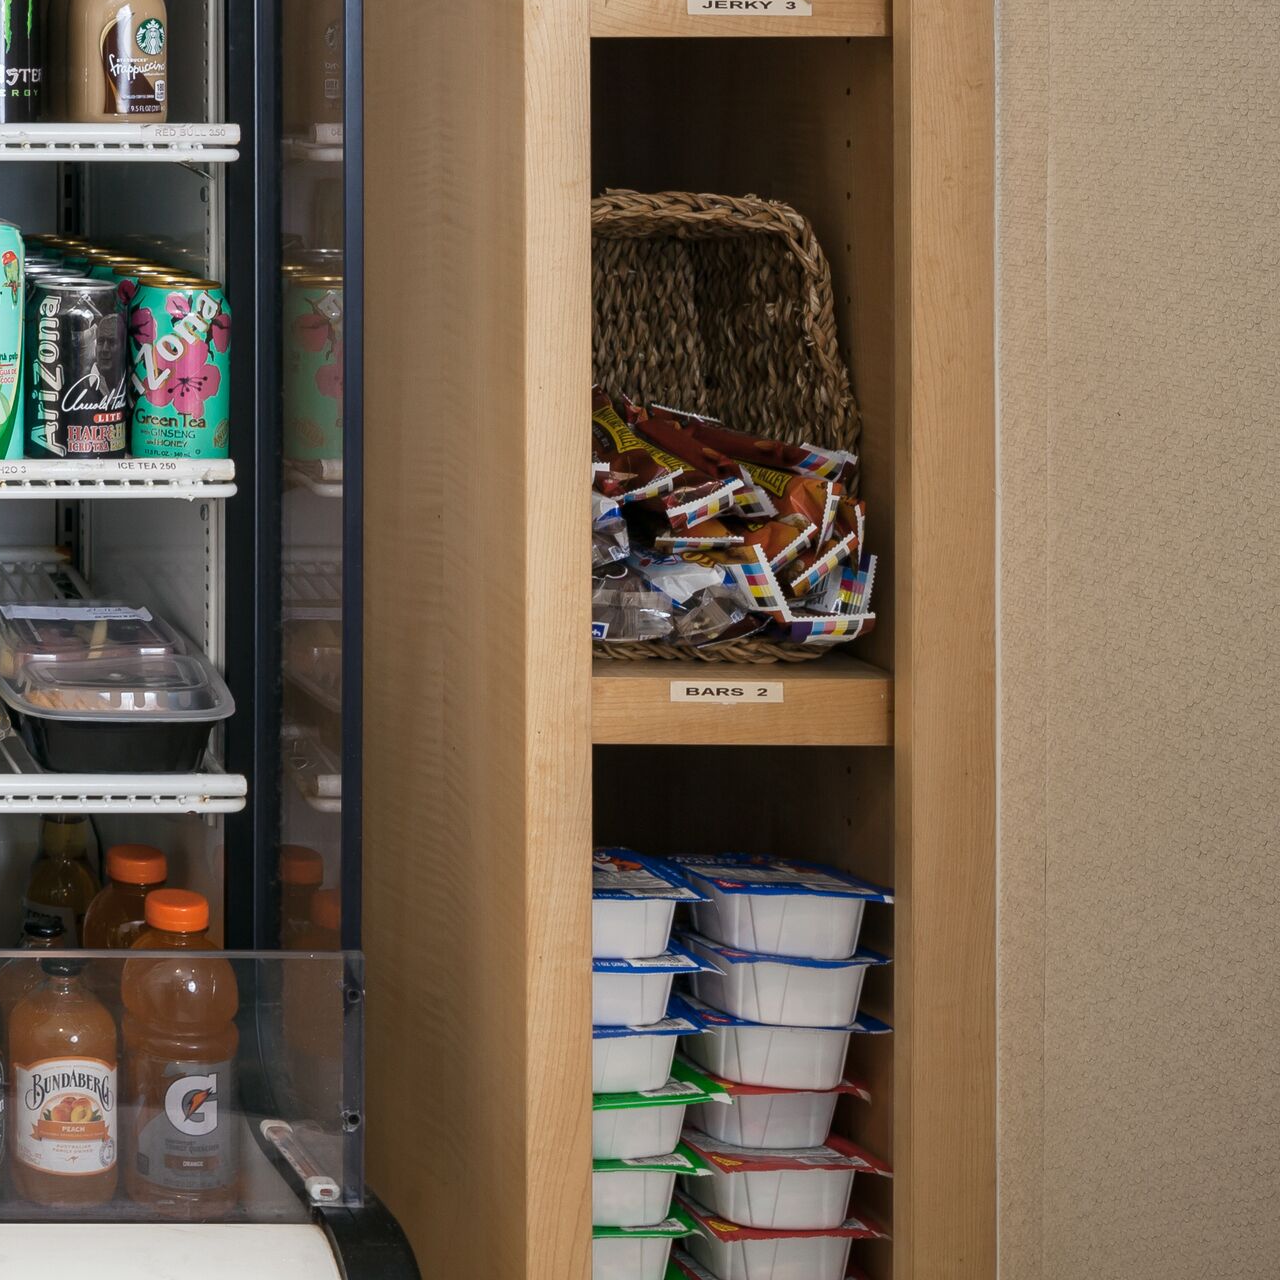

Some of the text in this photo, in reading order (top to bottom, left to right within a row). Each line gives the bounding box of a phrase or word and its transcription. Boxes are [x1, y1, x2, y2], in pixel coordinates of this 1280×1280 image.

[702, 0, 796, 10] JERKY 3
[154, 129, 176, 137] RED
[180, 128, 206, 137] BULL
[135, 408, 206, 429] Green Tea
[21, 466, 27, 474] 3
[686, 687, 768, 696] BARS 2
[24, 1070, 114, 1111] BUNDABERG
